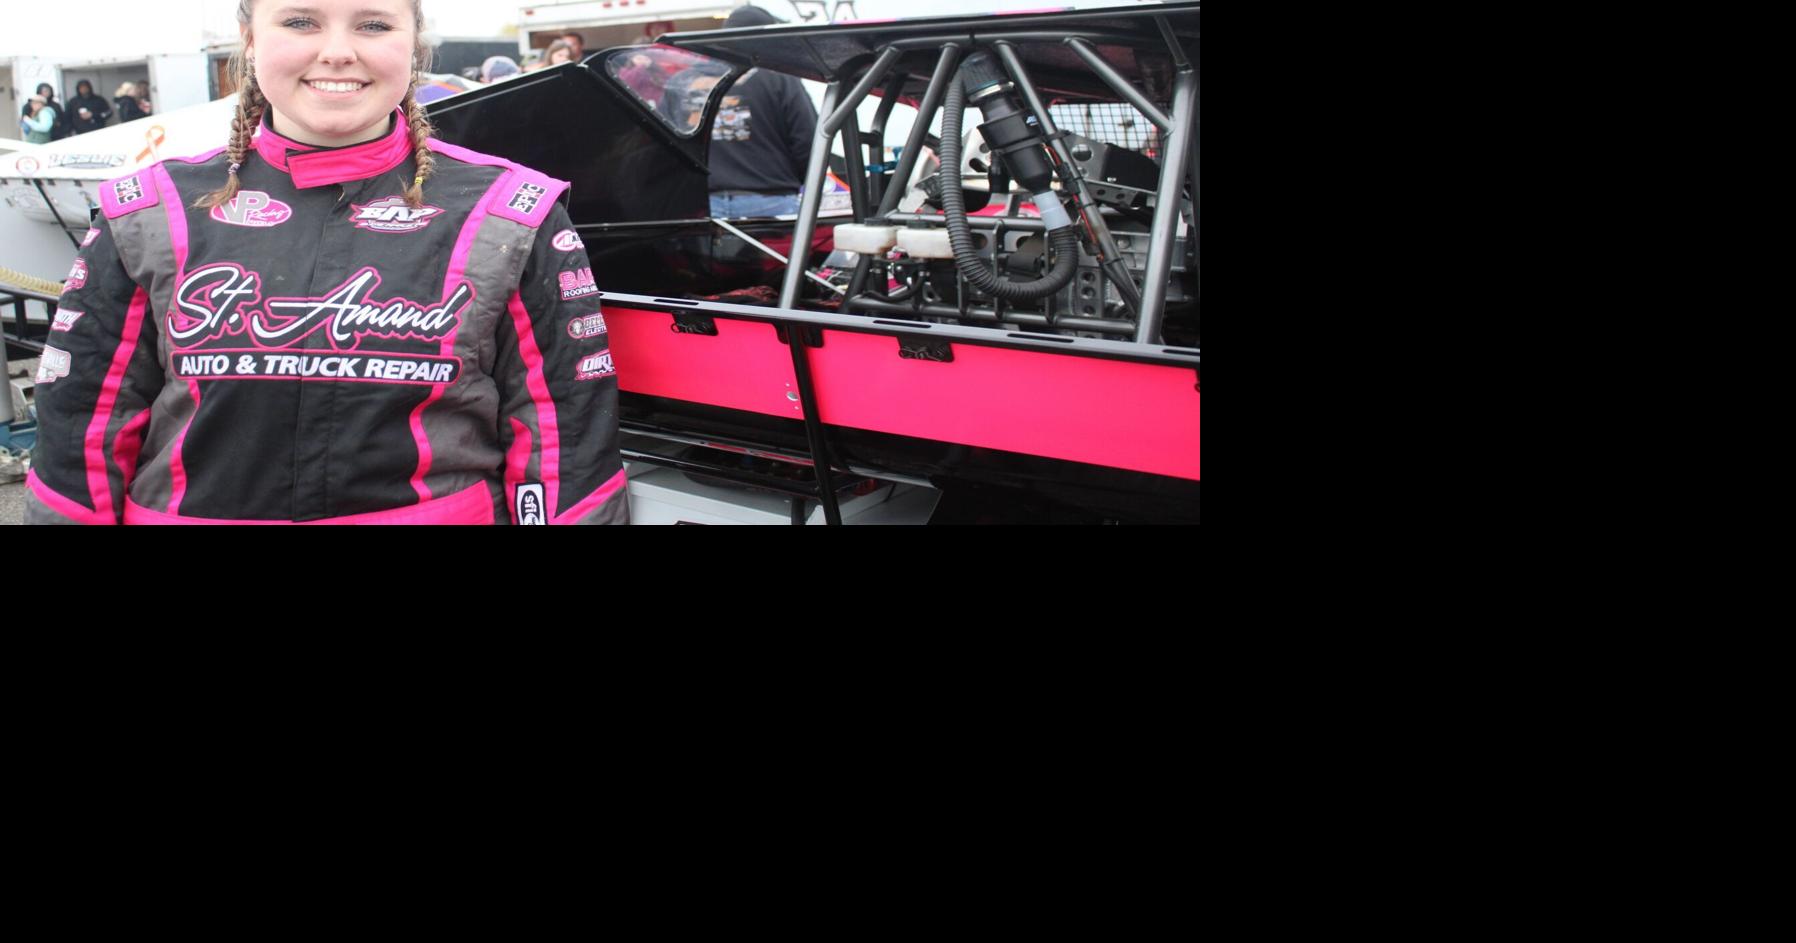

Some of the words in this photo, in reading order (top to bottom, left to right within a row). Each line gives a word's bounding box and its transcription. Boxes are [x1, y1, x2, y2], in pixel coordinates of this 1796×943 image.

[220, 191, 269, 224] VP
[356, 206, 438, 222] BAP
[508, 182, 546, 214] EPIC
[168, 266, 254, 339] St.
[251, 270, 468, 341] Amand
[180, 354, 229, 376] AUTO
[235, 354, 257, 375] &
[263, 354, 361, 378] TRUCK
[364, 359, 454, 383] REPAIR
